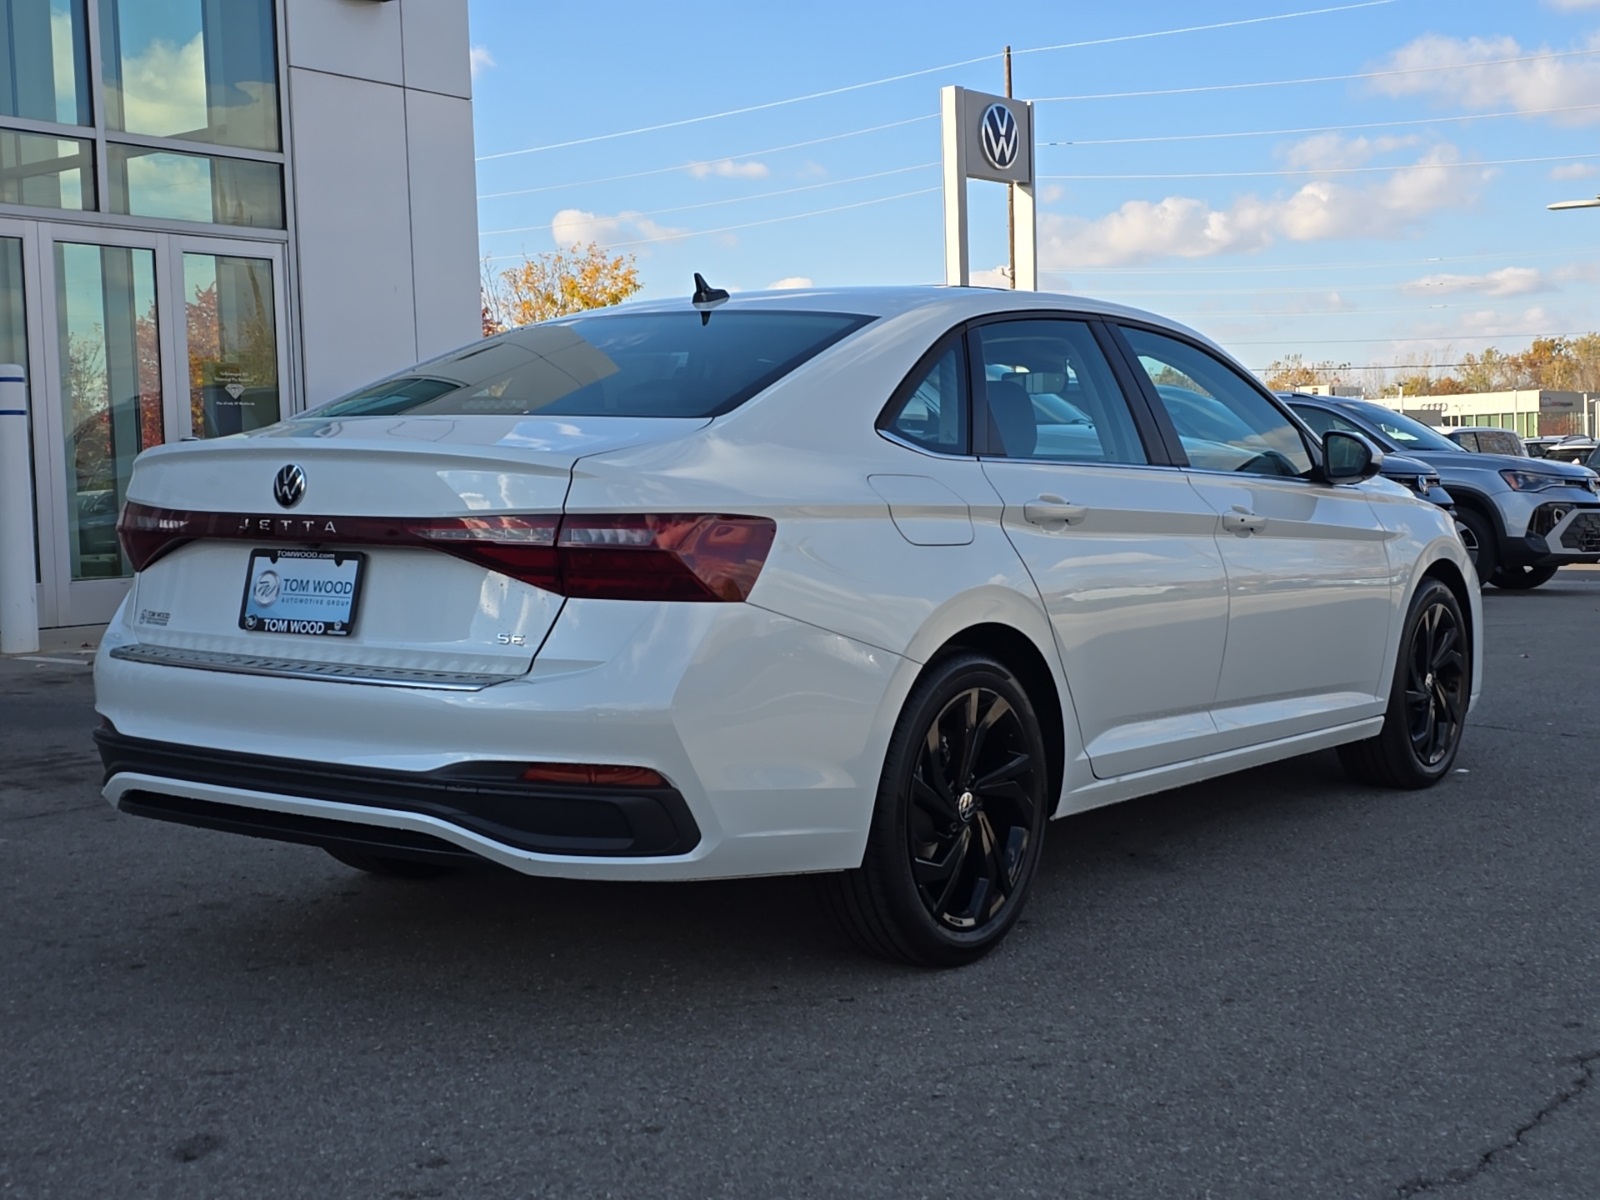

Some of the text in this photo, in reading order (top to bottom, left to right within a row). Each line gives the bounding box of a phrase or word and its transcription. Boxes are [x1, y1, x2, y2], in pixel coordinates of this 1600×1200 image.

[239, 518, 337, 533] JETTA
[283, 579, 353, 595] TOM WOOD
[264, 619, 288, 632] TOM
[289, 621, 325, 634] WOOD
[497, 633, 526, 647] SE
